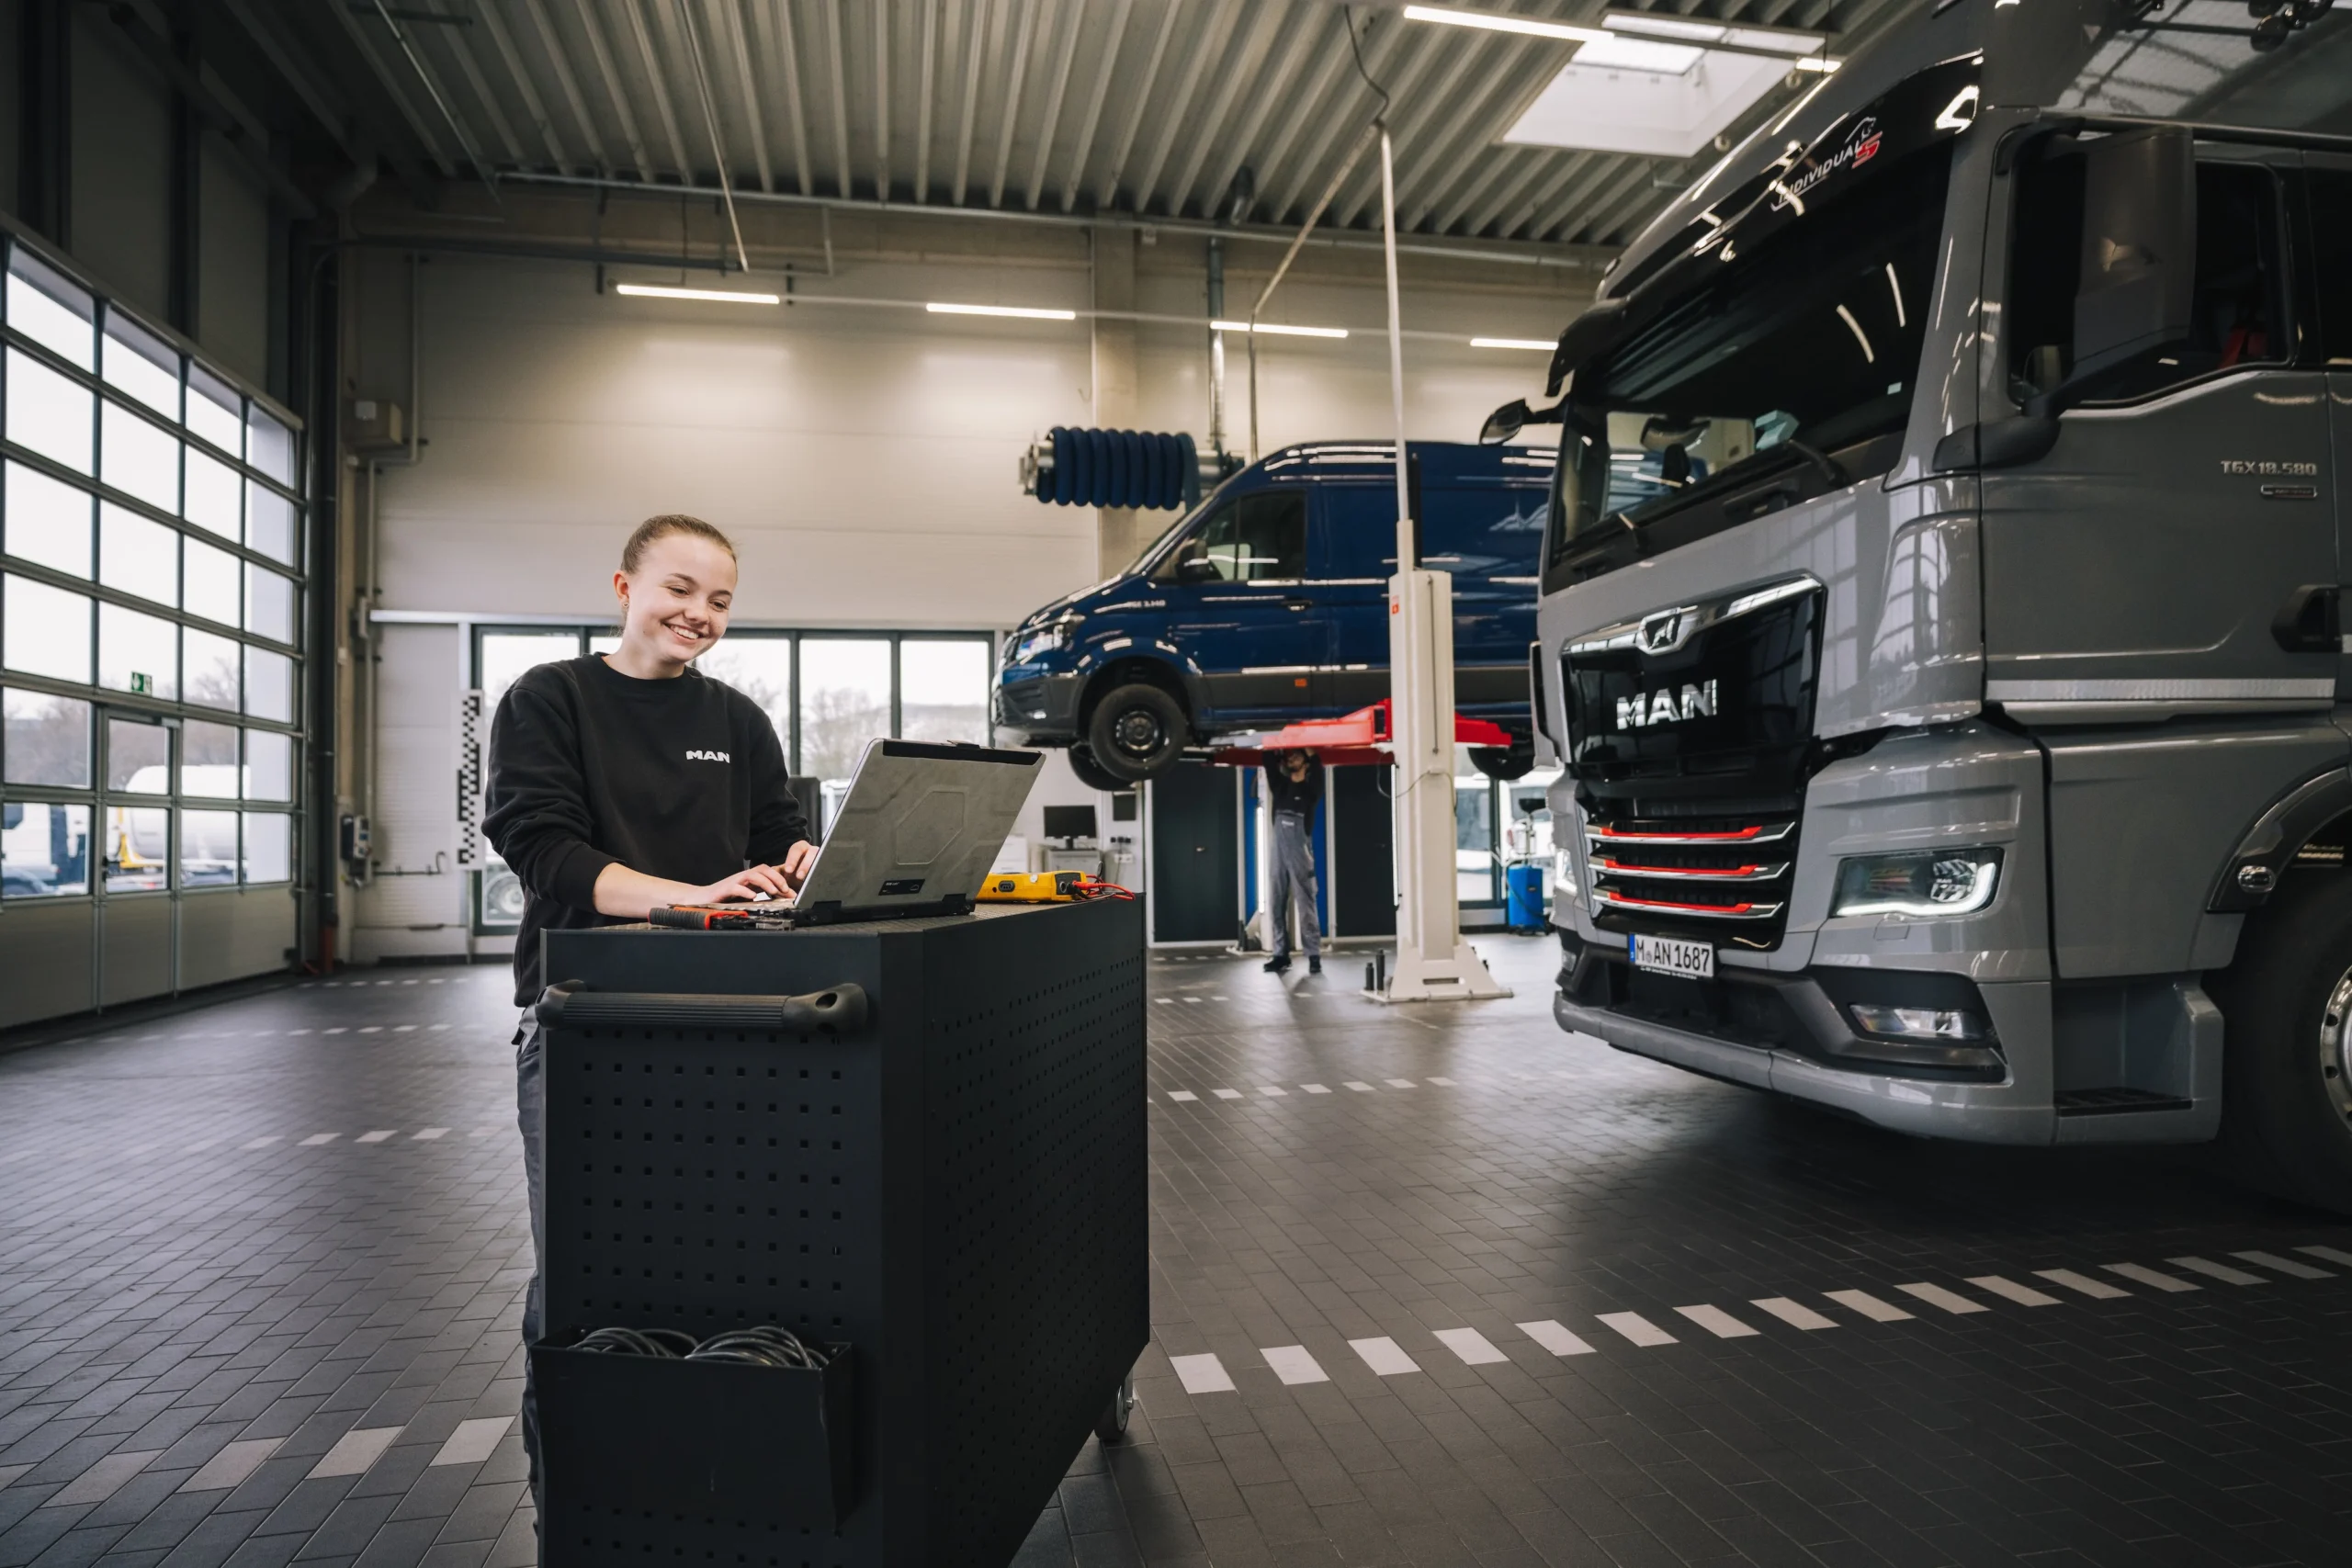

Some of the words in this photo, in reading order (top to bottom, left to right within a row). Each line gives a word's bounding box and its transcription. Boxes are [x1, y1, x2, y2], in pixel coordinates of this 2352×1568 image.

[2220, 460, 2256, 475] TGX
[2257, 461, 2317, 476] 18.580
[1616, 679, 1717, 730] MAN
[685, 750, 730, 764] MAN
[1674, 944, 1710, 972] 1687
